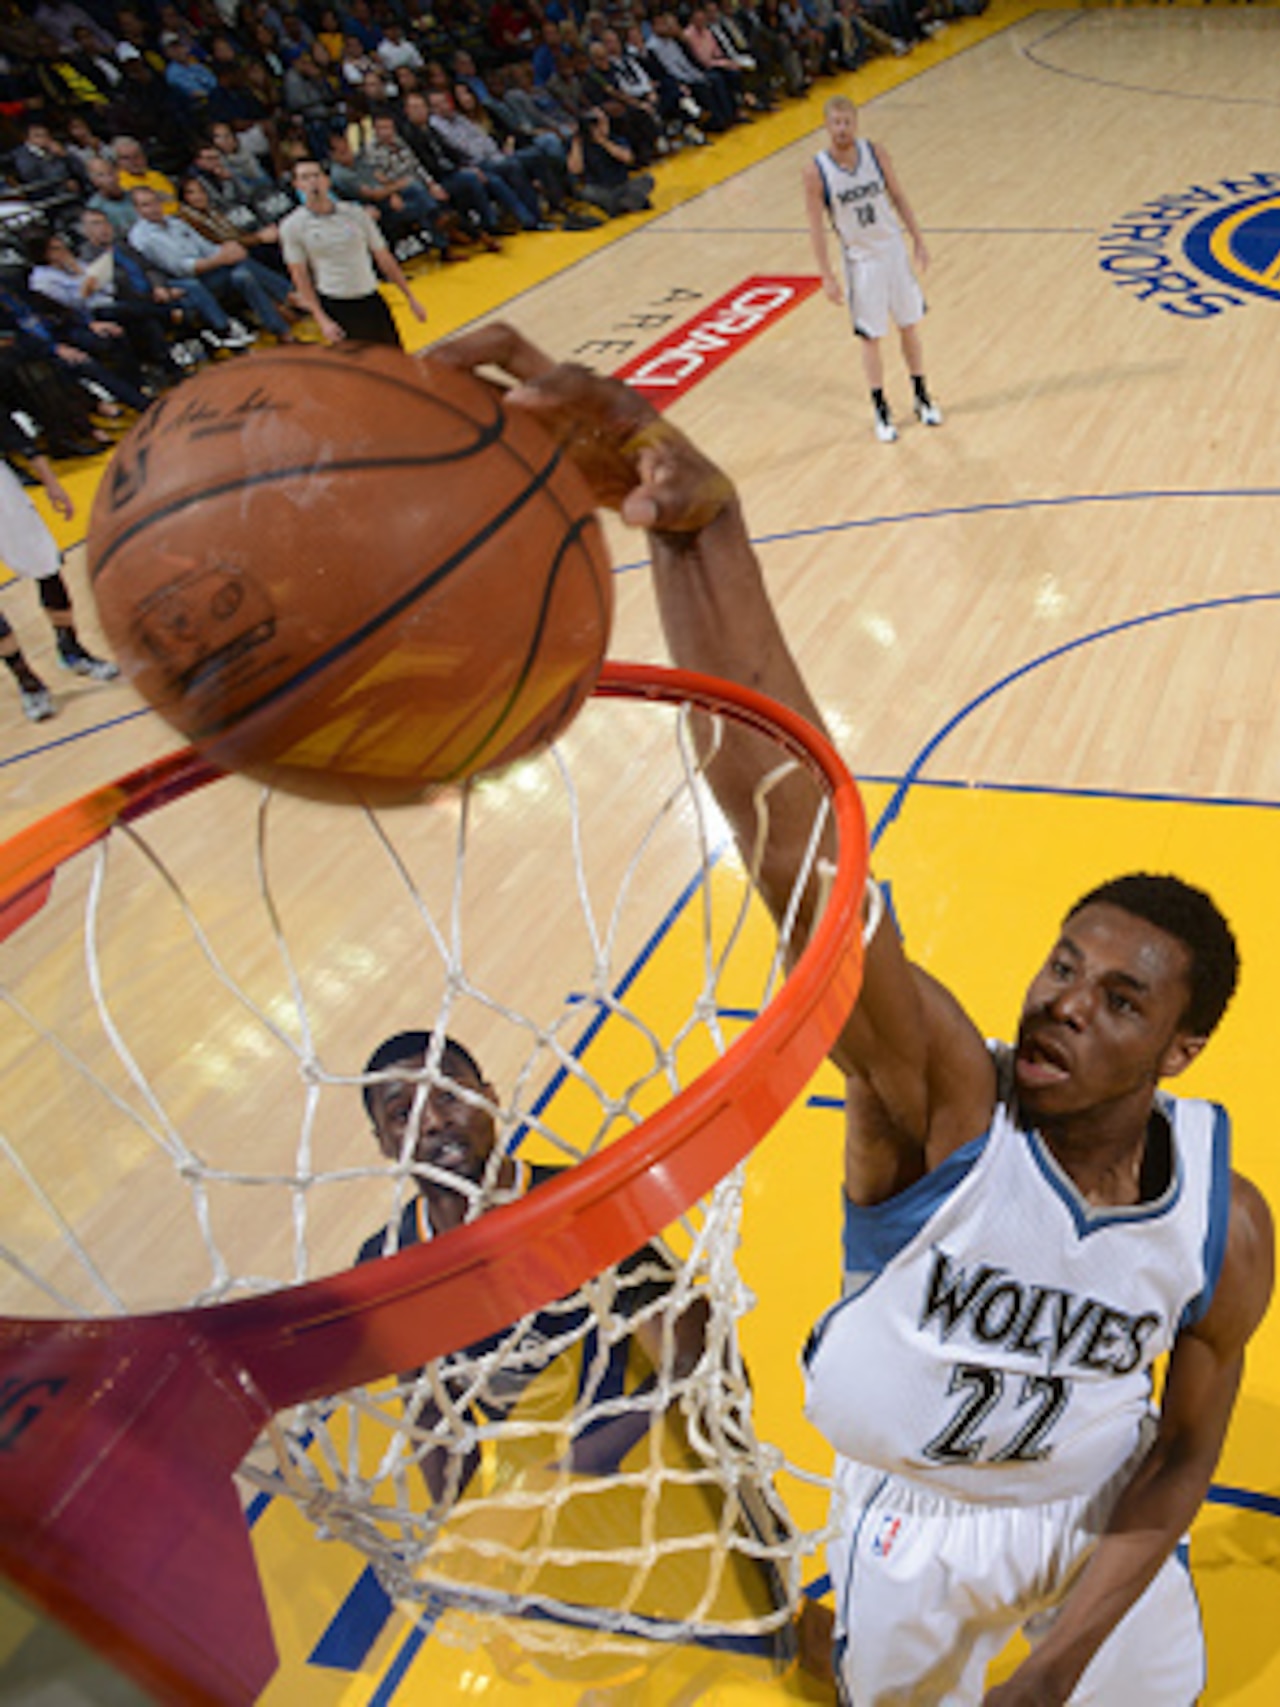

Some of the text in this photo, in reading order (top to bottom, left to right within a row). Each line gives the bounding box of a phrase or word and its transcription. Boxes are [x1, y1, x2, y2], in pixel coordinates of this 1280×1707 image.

[623, 285, 796, 386] ORACL
[918, 1242, 1160, 1376] WOLVES
[922, 1362, 1070, 1464] 22
